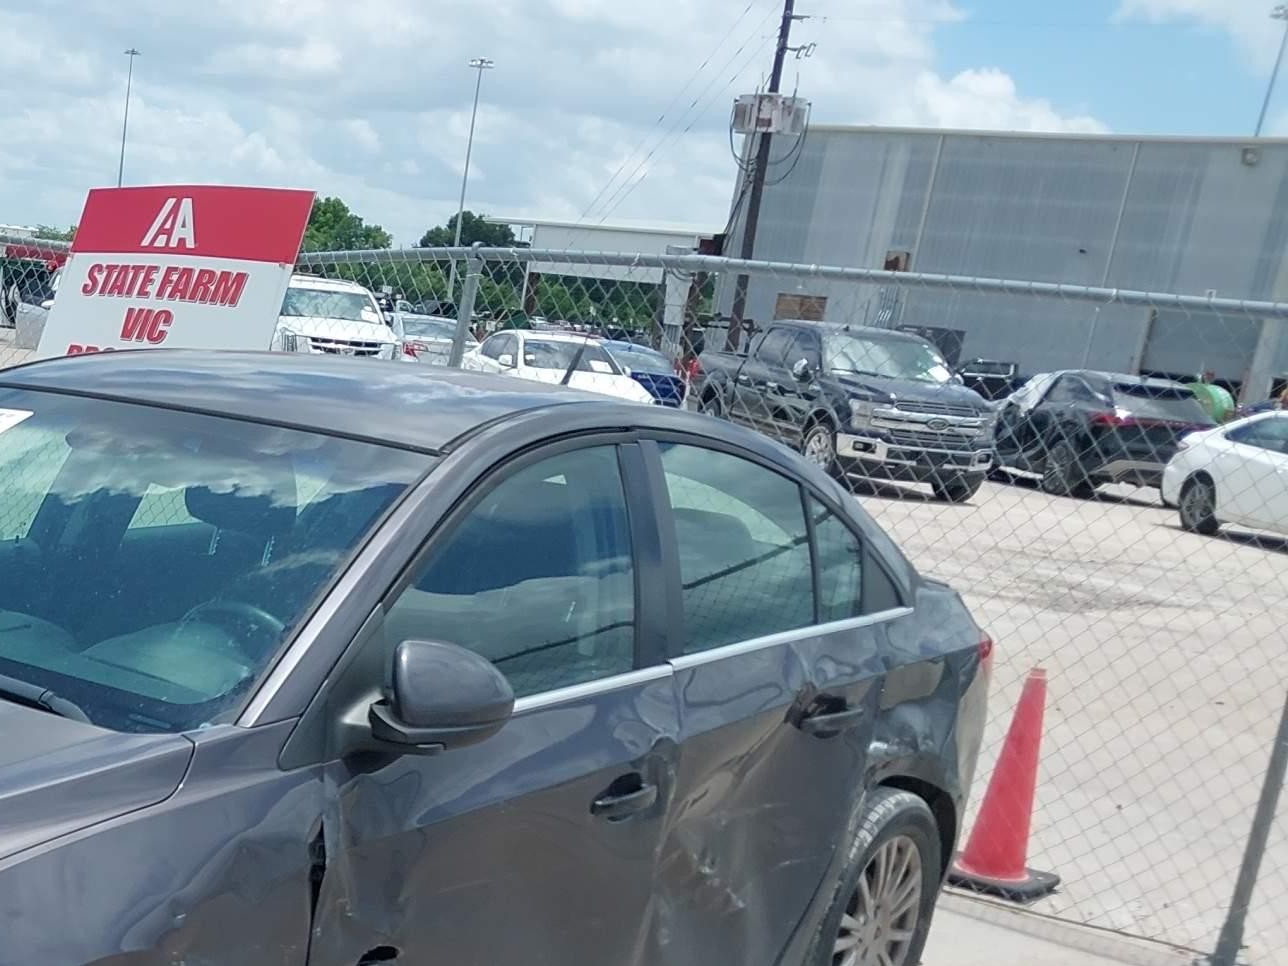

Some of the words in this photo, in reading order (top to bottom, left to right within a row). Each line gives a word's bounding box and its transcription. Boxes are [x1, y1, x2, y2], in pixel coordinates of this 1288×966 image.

[82, 264, 158, 299] STATE
[155, 266, 249, 307] FARM
[120, 307, 174, 344] VIC
